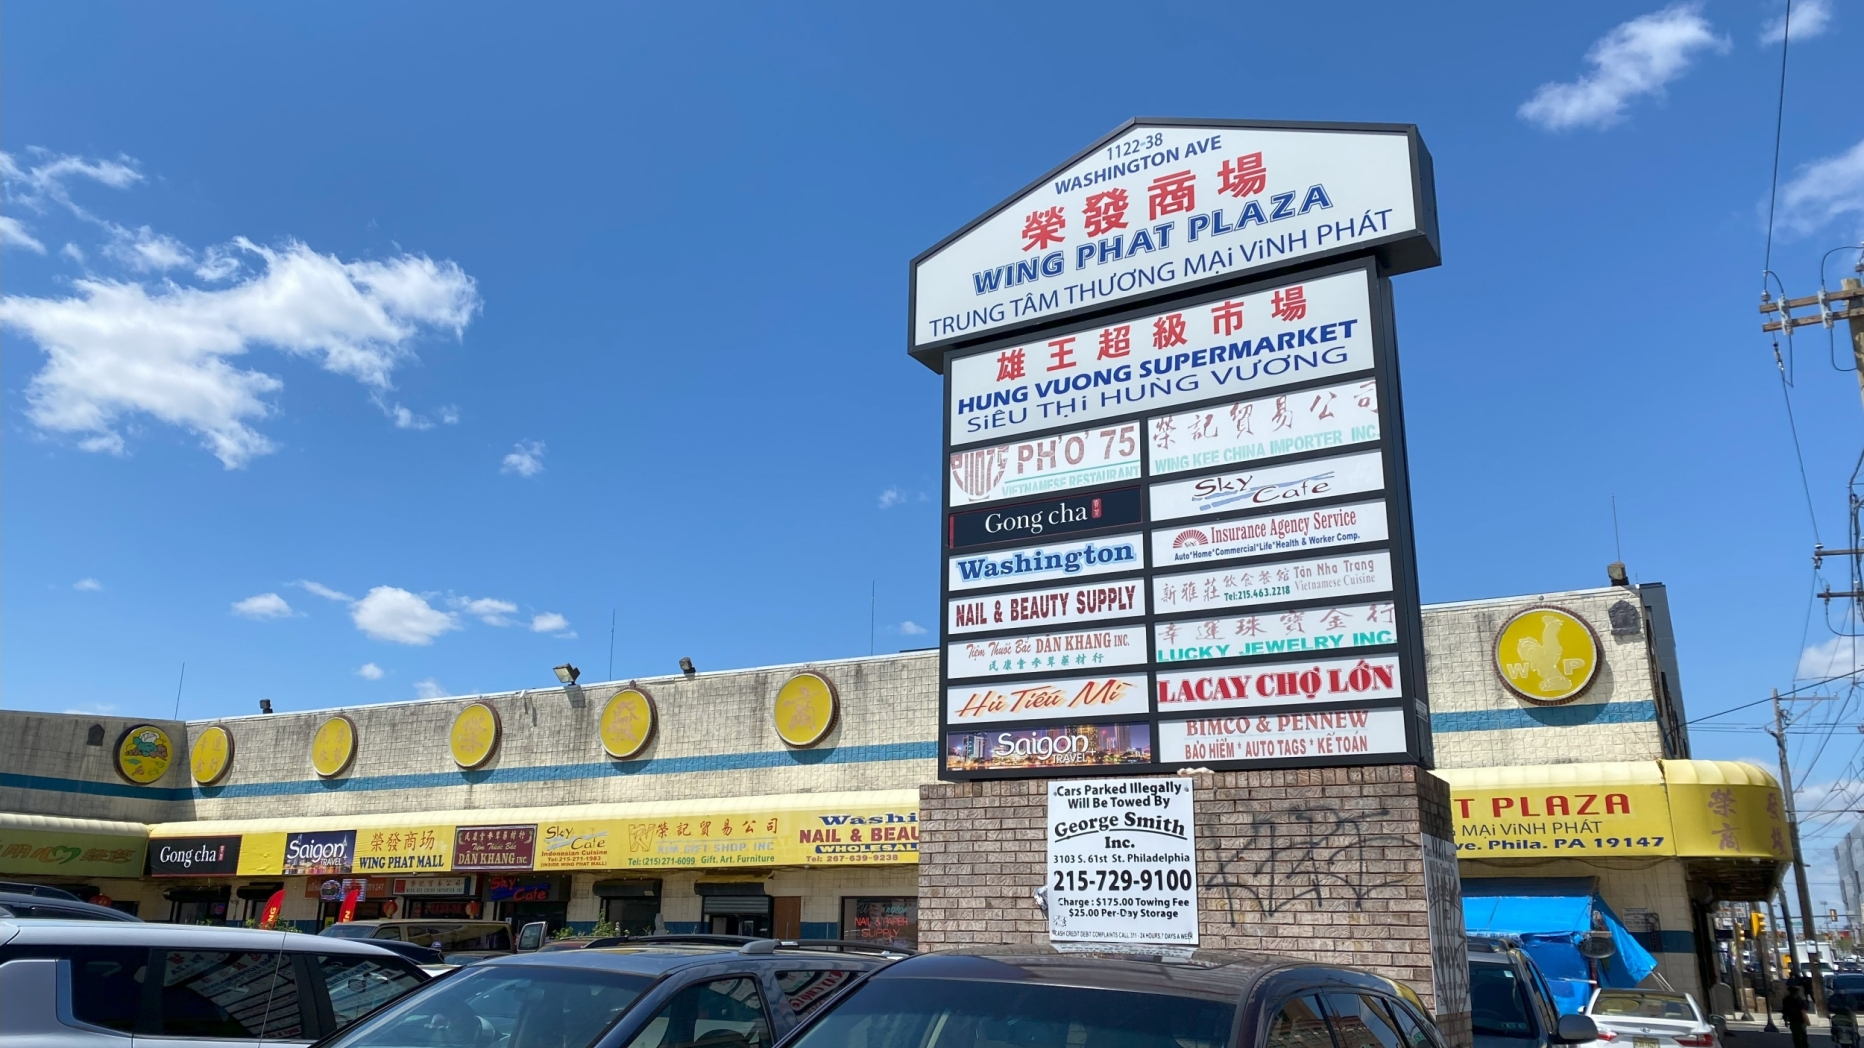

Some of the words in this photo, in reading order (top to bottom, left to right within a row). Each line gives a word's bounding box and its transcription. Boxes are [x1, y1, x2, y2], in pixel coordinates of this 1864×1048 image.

[1107, 133, 1163, 160] 1122-38
[1055, 147, 1179, 194] WASHINGTON
[1185, 135, 1222, 158] AVE
[1022, 151, 1266, 252] 榮發商場
[972, 251, 1064, 295] WING
[1076, 222, 1174, 270] PHAT
[1188, 184, 1333, 243] PLAZA
[929, 304, 1004, 336] TRUNG
[1010, 291, 1059, 317] TÂM
[1064, 262, 1175, 304] THƯƠNG
[1317, 208, 1393, 245] PHÁT
[996, 285, 1307, 382] 雄王超級市場
[958, 386, 1029, 414] HUNG
[1035, 365, 1132, 398] VUONG
[1139, 319, 1358, 378] SUPERMARKET
[1211, 346, 1348, 385] VƯƠNG
[1100, 426, 1135, 460] 75
[1155, 455, 1189, 474] WING
[1193, 450, 1219, 468] KEE
[1223, 442, 1266, 463] CHINA
[1270, 429, 1343, 456] IMPORTER
[1351, 424, 1380, 443] INC.
[1001, 474, 1067, 497] VIETNAMESE
[1069, 465, 1140, 487] RESTAURANT
[1195, 475, 1253, 498] Sky
[1252, 480, 1332, 504] Cafe
[985, 511, 1044, 534] Gong
[1048, 502, 1088, 525] cha
[1210, 522, 1267, 544] Insurance
[1270, 513, 1310, 540] Agency
[1313, 508, 1357, 529] Service
[1301, 537, 1307, 546] &
[1308, 534, 1335, 545] Worker
[1337, 531, 1361, 543] Comp.
[957, 543, 1135, 581] Washington
[1317, 562, 1338, 576] Nha
[1344, 558, 1375, 574] Trang
[1224, 585, 1291, 602] Tel:215.463.2218
[1294, 577, 1342, 592] Vietnamese
[1344, 573, 1376, 587] Cuisine
[956, 602, 987, 628] NAIL
[994, 600, 1004, 624] &
[1011, 592, 1069, 621] BEAUTY
[1076, 585, 1136, 614] SUPPLY
[1065, 632, 1112, 652] KHANG
[1114, 634, 1130, 647] INC.
[1157, 644, 1233, 663] LUCKY
[1239, 634, 1344, 656] JEWELRY
[1353, 630, 1397, 647] INC.
[1157, 674, 1253, 704] LACAY
[1186, 716, 1251, 736] BIMCO
[1255, 715, 1271, 733] &
[1277, 710, 1369, 732] PENNEW
[996, 731, 1089, 760] Saigon
[1246, 740, 1274, 757] AUTO
[1277, 738, 1307, 755] TAGS
[1335, 731, 1367, 752] TOÁN
[1052, 752, 1088, 764] TRAVEL
[1056, 785, 1082, 797] Cars
[1084, 782, 1127, 796] Parked
[1130, 781, 1182, 797] Illegally
[1068, 797, 1090, 809] Will
[1093, 797, 1108, 809] Be
[1110, 796, 1150, 808] Towed
[1154, 796, 1170, 809] By
[1492, 793, 1631, 818] PLAZA
[656, 817, 778, 839] 榮記貿易公司
[819, 811, 919, 826] Washi
[1054, 815, 1119, 837] George
[1124, 811, 1185, 836] Smith
[1553, 819, 1603, 834] PHÁT
[545, 826, 574, 840] Sky
[800, 829, 841, 843] NAIL
[850, 828, 862, 842] &
[871, 826, 919, 841] BEAU
[1104, 836, 1136, 849] Inc.
[1455, 840, 1482, 851] ve.
[1489, 839, 1548, 850] Phila.
[1555, 838, 1586, 849] PA
[1594, 837, 1664, 848] 19147
[160, 845, 191, 868] Gong
[195, 844, 216, 863] cha
[287, 839, 345, 863] Saigon
[321, 857, 342, 866] TRAVEL
[359, 857, 386, 870] WING
[387, 855, 416, 869] PHAT
[416, 854, 445, 868] MALL
[480, 852, 515, 864] KHANG
[737, 854, 775, 863] Furniture
[827, 854, 898, 862] 267-639-9238
[1054, 855, 1076, 864] 3103
[1077, 854, 1086, 863] S.
[1088, 854, 1108, 863] 61st
[1112, 854, 1125, 863] St.
[1127, 853, 1190, 865] Philadelphia
[1053, 869, 1192, 892] 215-729-9100
[513, 888, 547, 901] Cafe
[1096, 897, 1134, 907] $175.00
[1136, 897, 1171, 908] Towing
[1172, 897, 1190, 907] Fee
[855, 917, 872, 926] NAIL
[1069, 908, 1099, 918] $25.00
[1101, 908, 1138, 919] Per-Day
[1140, 908, 1179, 919] Storage
[861, 928, 900, 938] SUPPLY
[1092, 931, 1118, 939] COMPLAINTS
[1118, 931, 1130, 939] CALL
